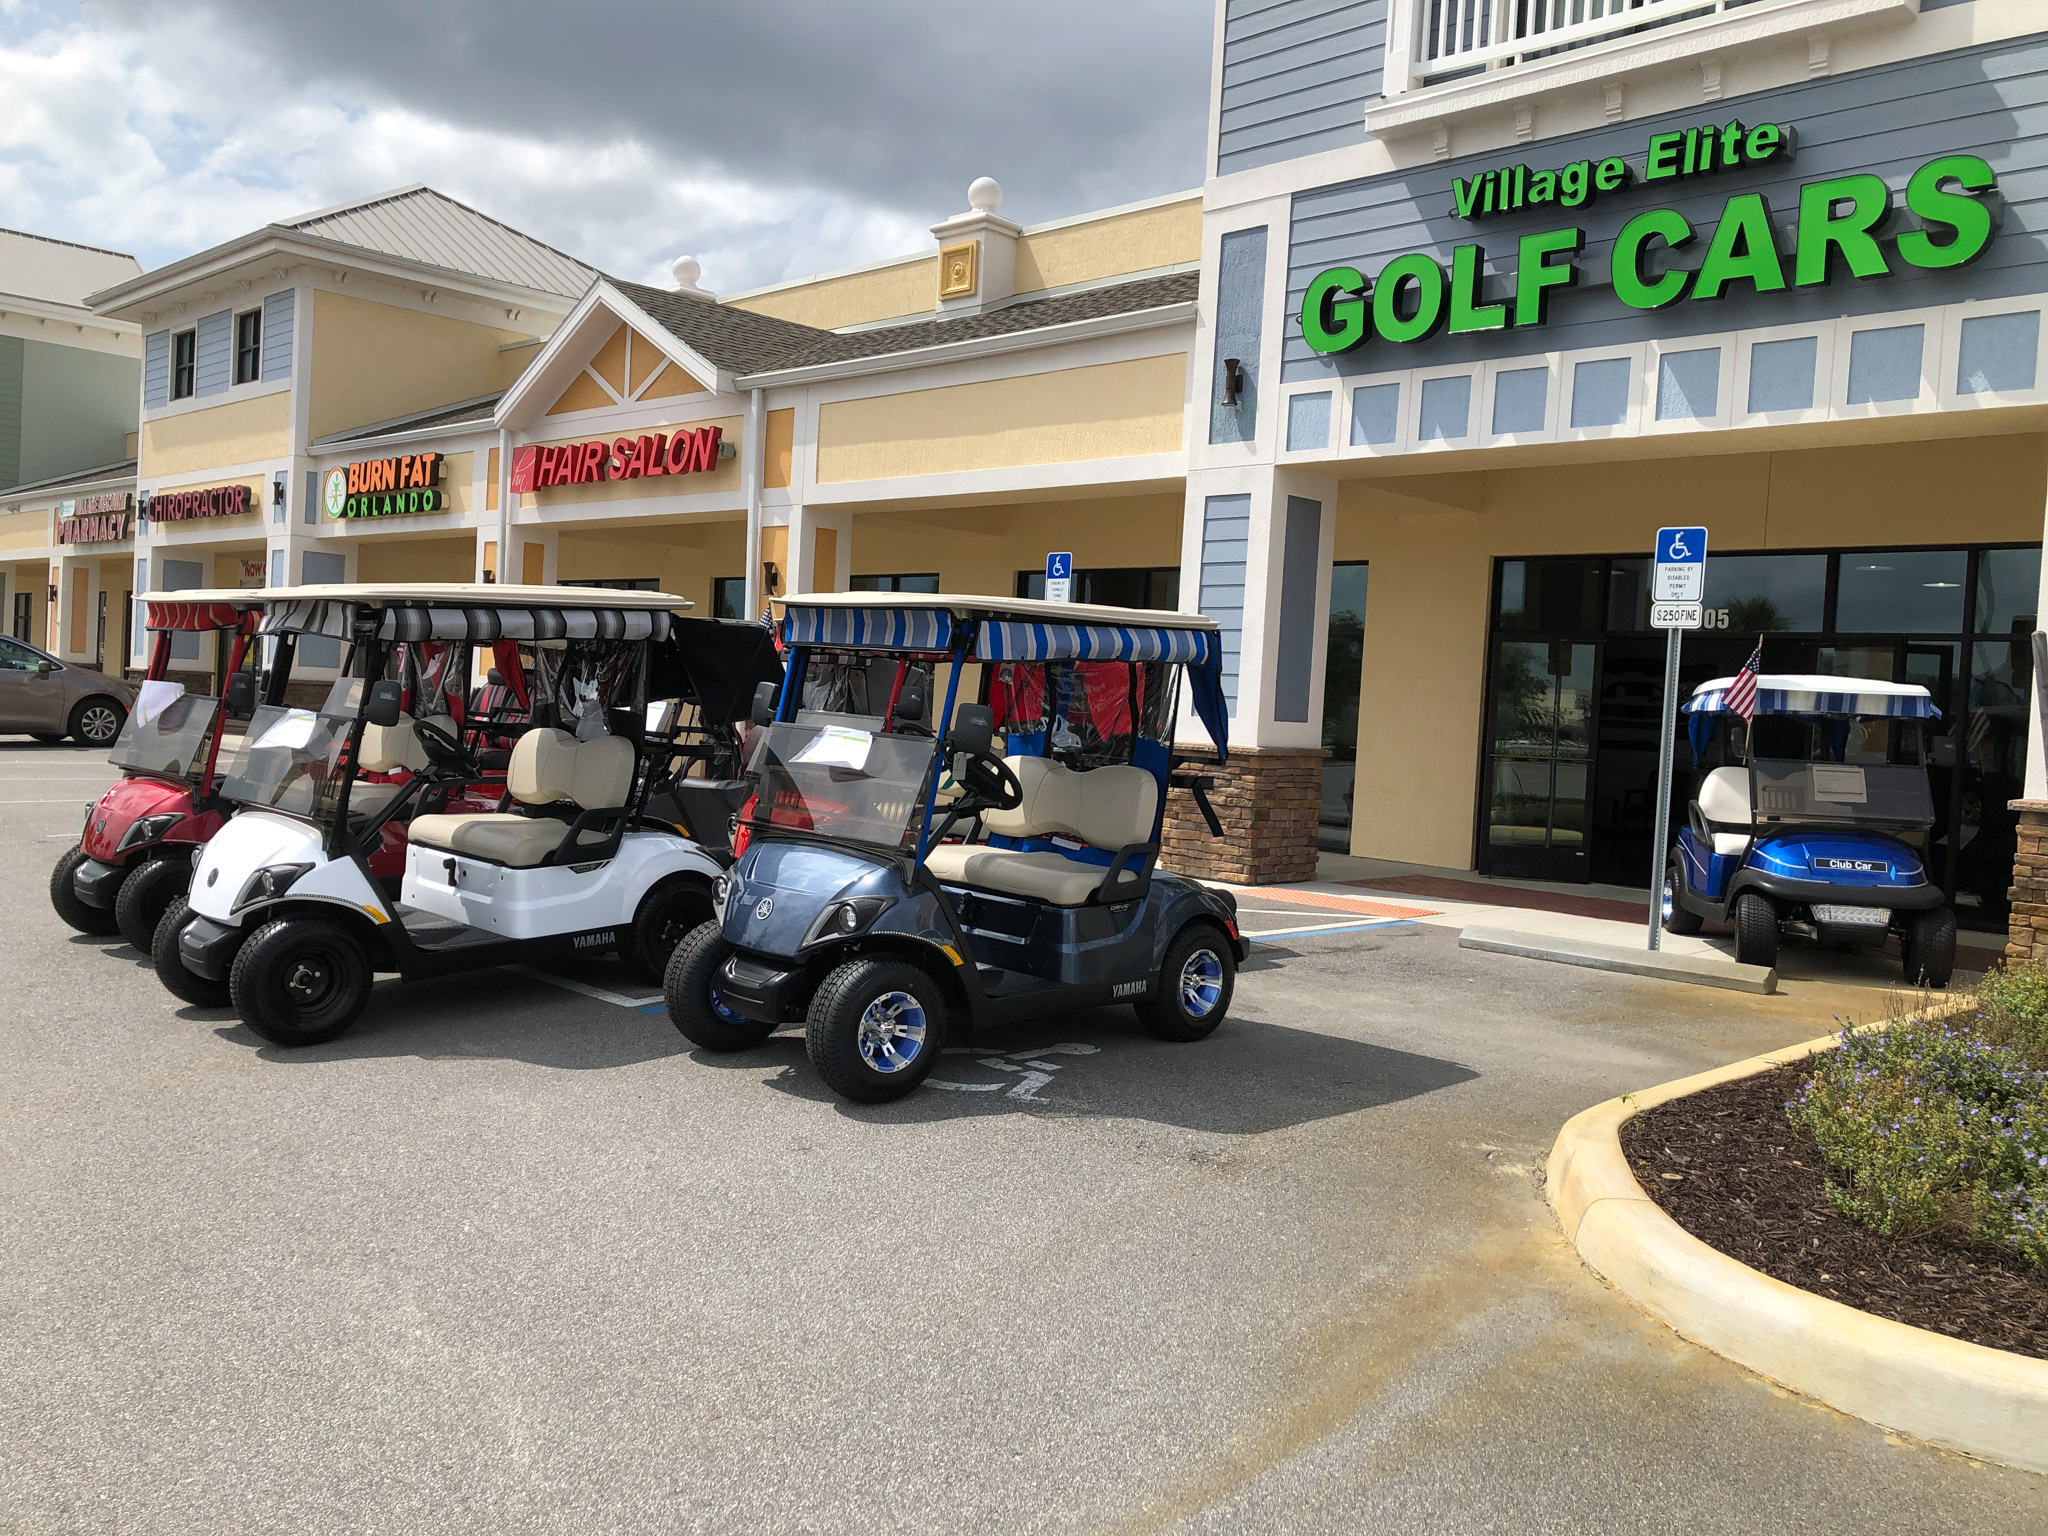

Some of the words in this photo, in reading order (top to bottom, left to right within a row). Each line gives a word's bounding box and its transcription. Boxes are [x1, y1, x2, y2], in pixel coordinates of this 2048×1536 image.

[1453, 156, 1624, 218] Village
[1646, 119, 1780, 181] Elite
[1301, 227, 1580, 354] GOLF
[1611, 154, 1995, 310] CARS
[537, 440, 604, 487] HAIR
[608, 425, 717, 481] SALON
[347, 456, 397, 495] BURN
[399, 451, 436, 489] FAT
[147, 484, 244, 523] CHIROPRACTOR
[347, 489, 434, 518] ORLANDO
[57, 513, 126, 544] PHARMACY
[244, 562, 263, 578] NOW
[1829, 859, 1853, 869] Club
[1854, 861, 1872, 870] Car
[573, 931, 616, 949] YAMAHA
[1112, 980, 1147, 998] YAMAHA
